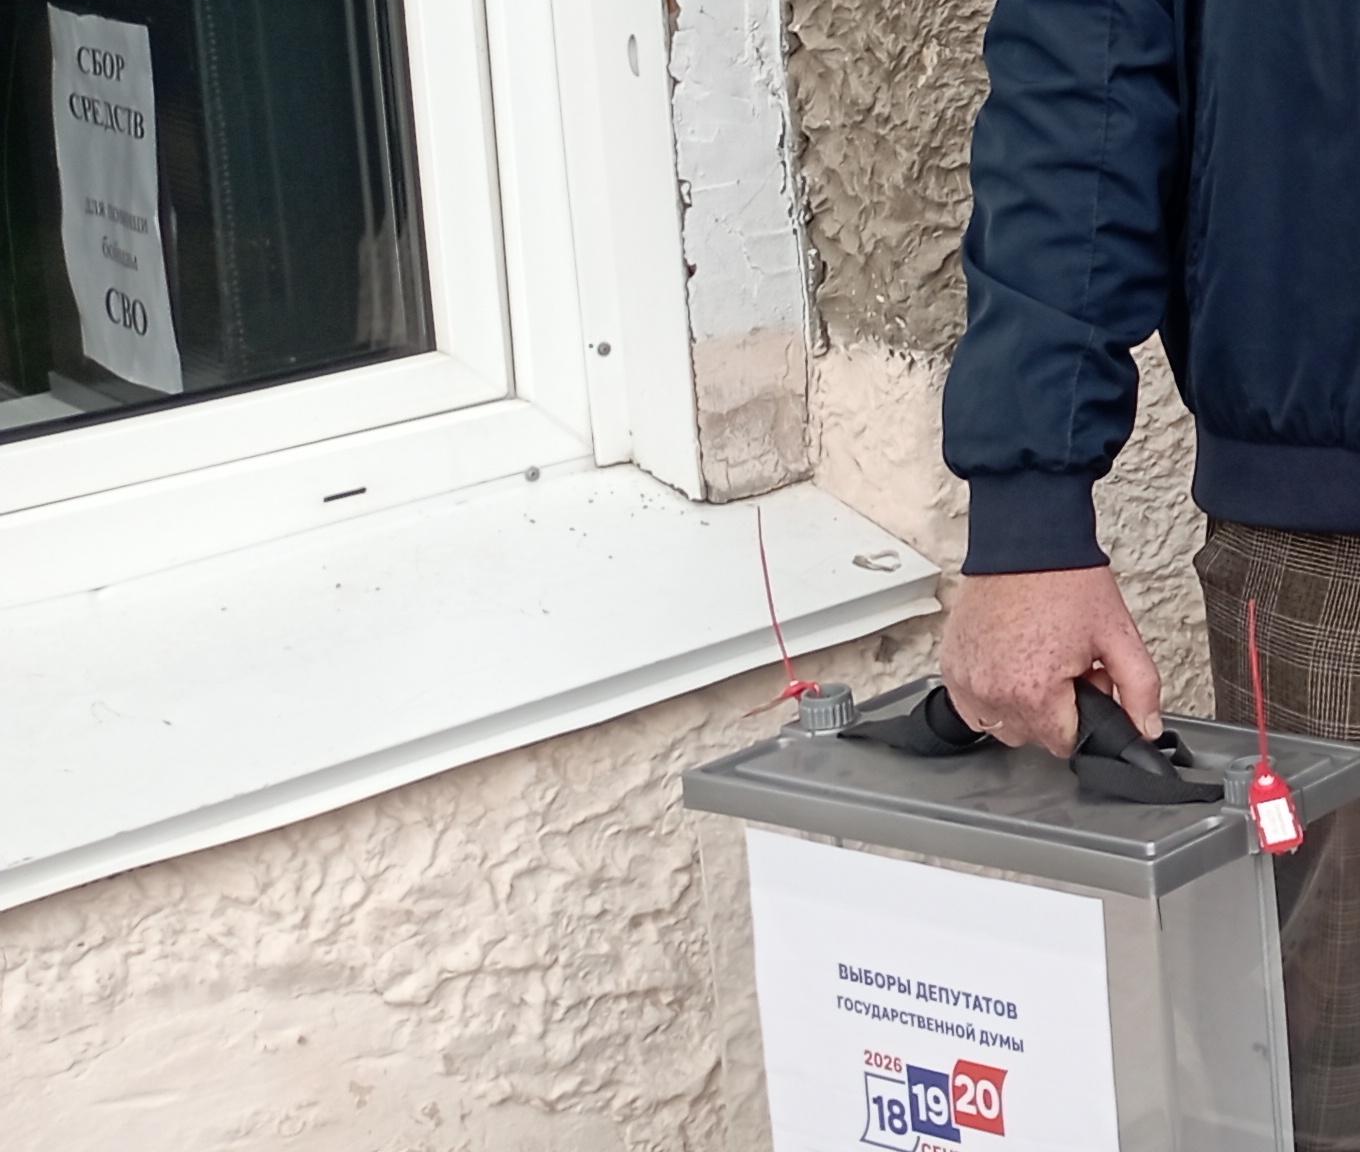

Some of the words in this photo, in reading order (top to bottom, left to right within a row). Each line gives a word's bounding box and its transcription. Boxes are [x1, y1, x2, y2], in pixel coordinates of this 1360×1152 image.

[77, 45, 125, 82] СБОР
[69, 92, 145, 140] СРЕДСТВ
[105, 287, 148, 336] СВО
[838, 963, 912, 996] ВЫБОРЫ
[915, 980, 1018, 1020] ДЕПУТАТОВ
[837, 995, 975, 1042] ГОСУДАРСТВЕННОЙ
[979, 1029, 1024, 1053] ДУМЫ
[864, 1049, 903, 1073] 2026
[872, 1095, 908, 1135] 18
[912, 1083, 949, 1126] 19
[954, 1074, 1000, 1120] 20
